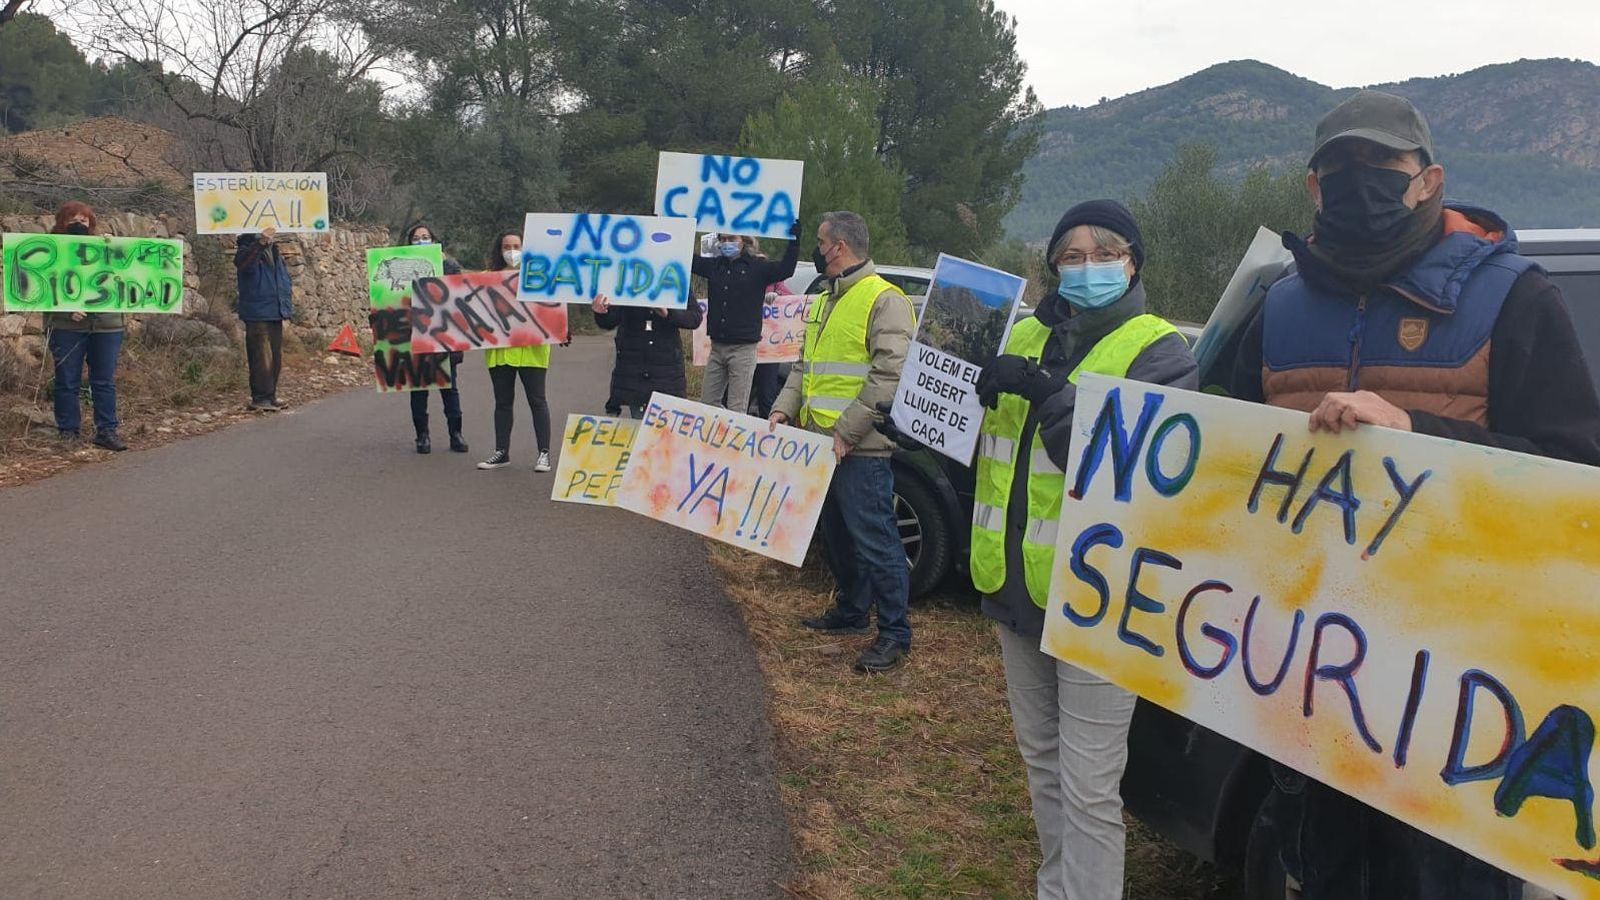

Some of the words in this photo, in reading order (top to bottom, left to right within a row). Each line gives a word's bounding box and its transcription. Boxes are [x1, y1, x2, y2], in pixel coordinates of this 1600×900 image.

[701, 155, 760, 186] NO
[566, 212, 643, 253] NO
[664, 186, 797, 234] CAZA
[521, 251, 689, 303] BATIDA
[411, 276, 450, 335] NO
[917, 371, 968, 405] DESERT
[919, 347, 961, 378] VOLEM
[962, 367, 980, 386] EL
[903, 389, 948, 422] LLIURE
[948, 411, 969, 432] DE
[911, 418, 945, 448] CAÇA
[644, 402, 820, 467] ESTERILIZACION
[1067, 386, 1202, 502] NO
[1247, 432, 1433, 560] HAY
[1062, 522, 1600, 881] SEGURIDA
